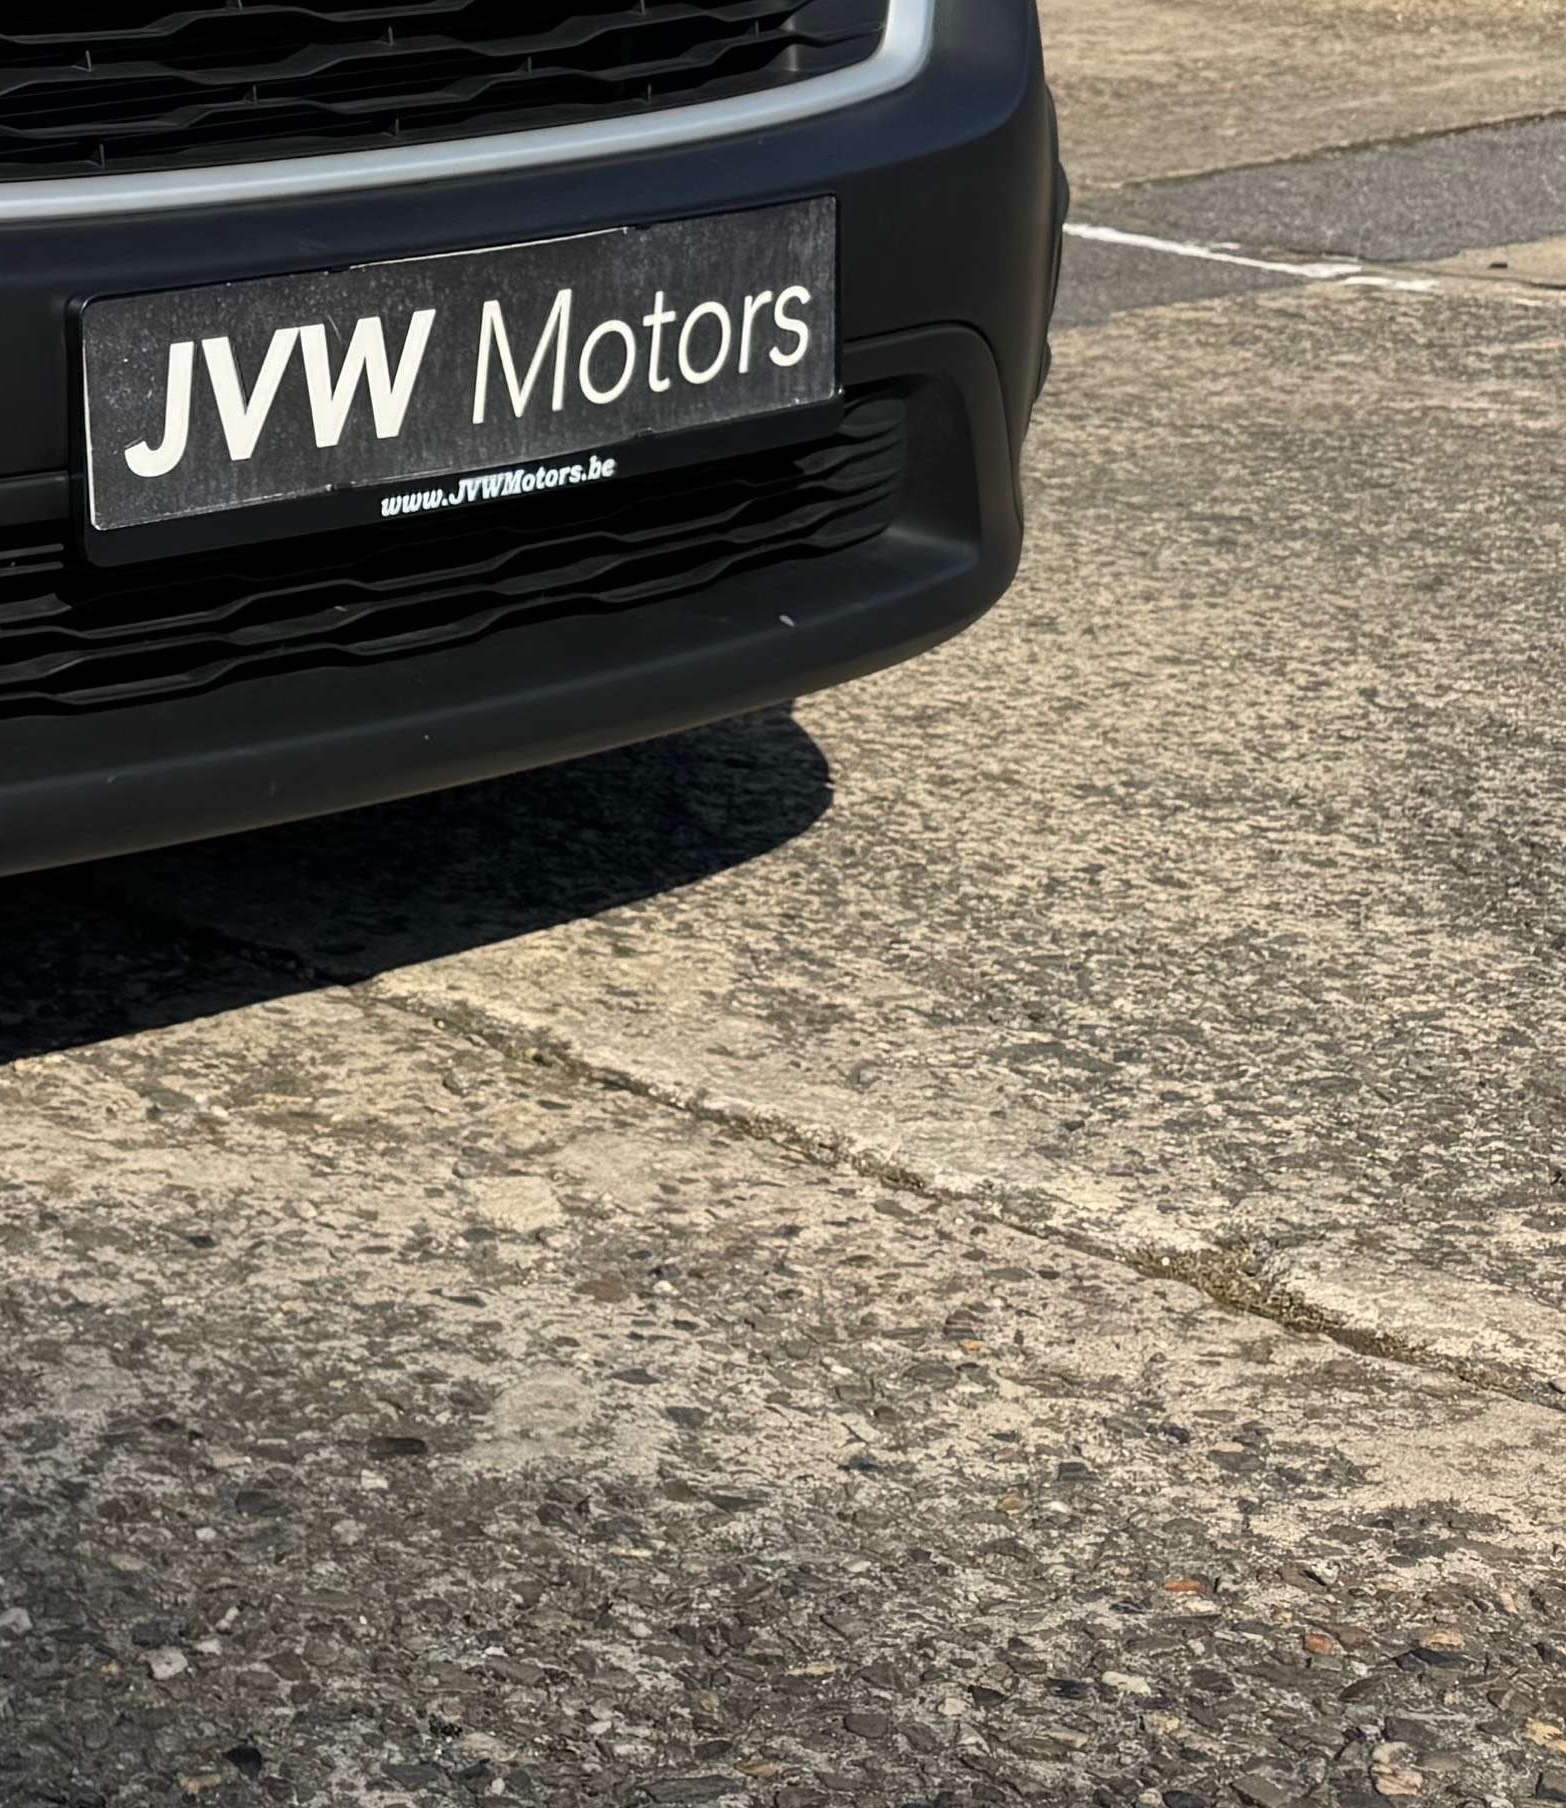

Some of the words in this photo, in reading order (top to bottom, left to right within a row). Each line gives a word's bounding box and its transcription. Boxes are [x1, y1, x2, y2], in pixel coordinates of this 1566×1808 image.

[124, 308, 437, 478] JVW
[472, 285, 813, 425] Motors
[380, 455, 618, 517] www.JVWMotors.be
